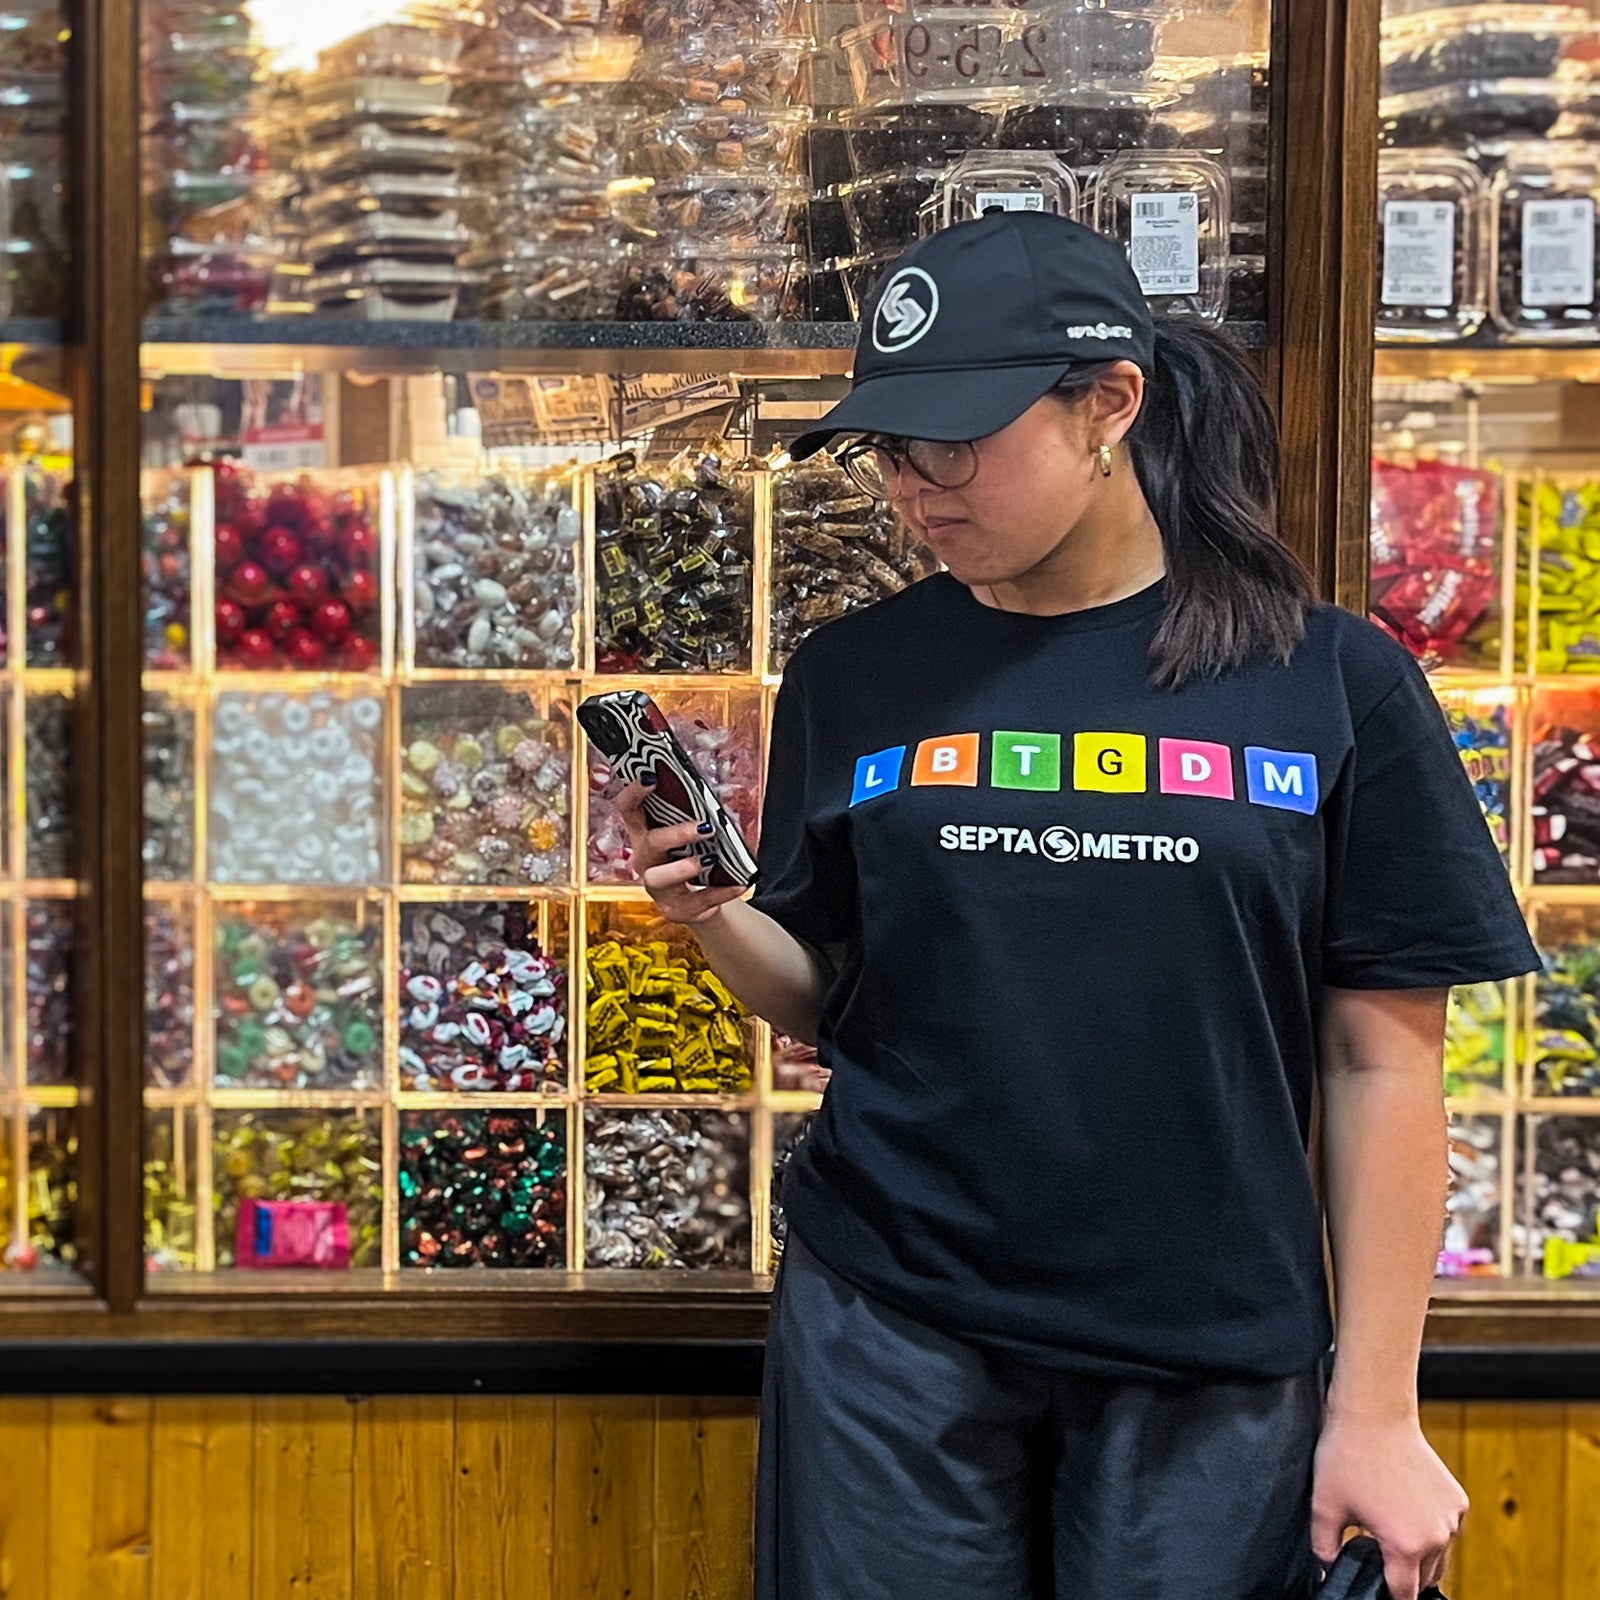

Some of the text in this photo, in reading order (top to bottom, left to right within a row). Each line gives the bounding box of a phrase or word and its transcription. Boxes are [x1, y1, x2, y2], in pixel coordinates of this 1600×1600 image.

[865, 745, 1303, 796] L B T G D M
[940, 824, 1200, 863] SEPTA METRO
